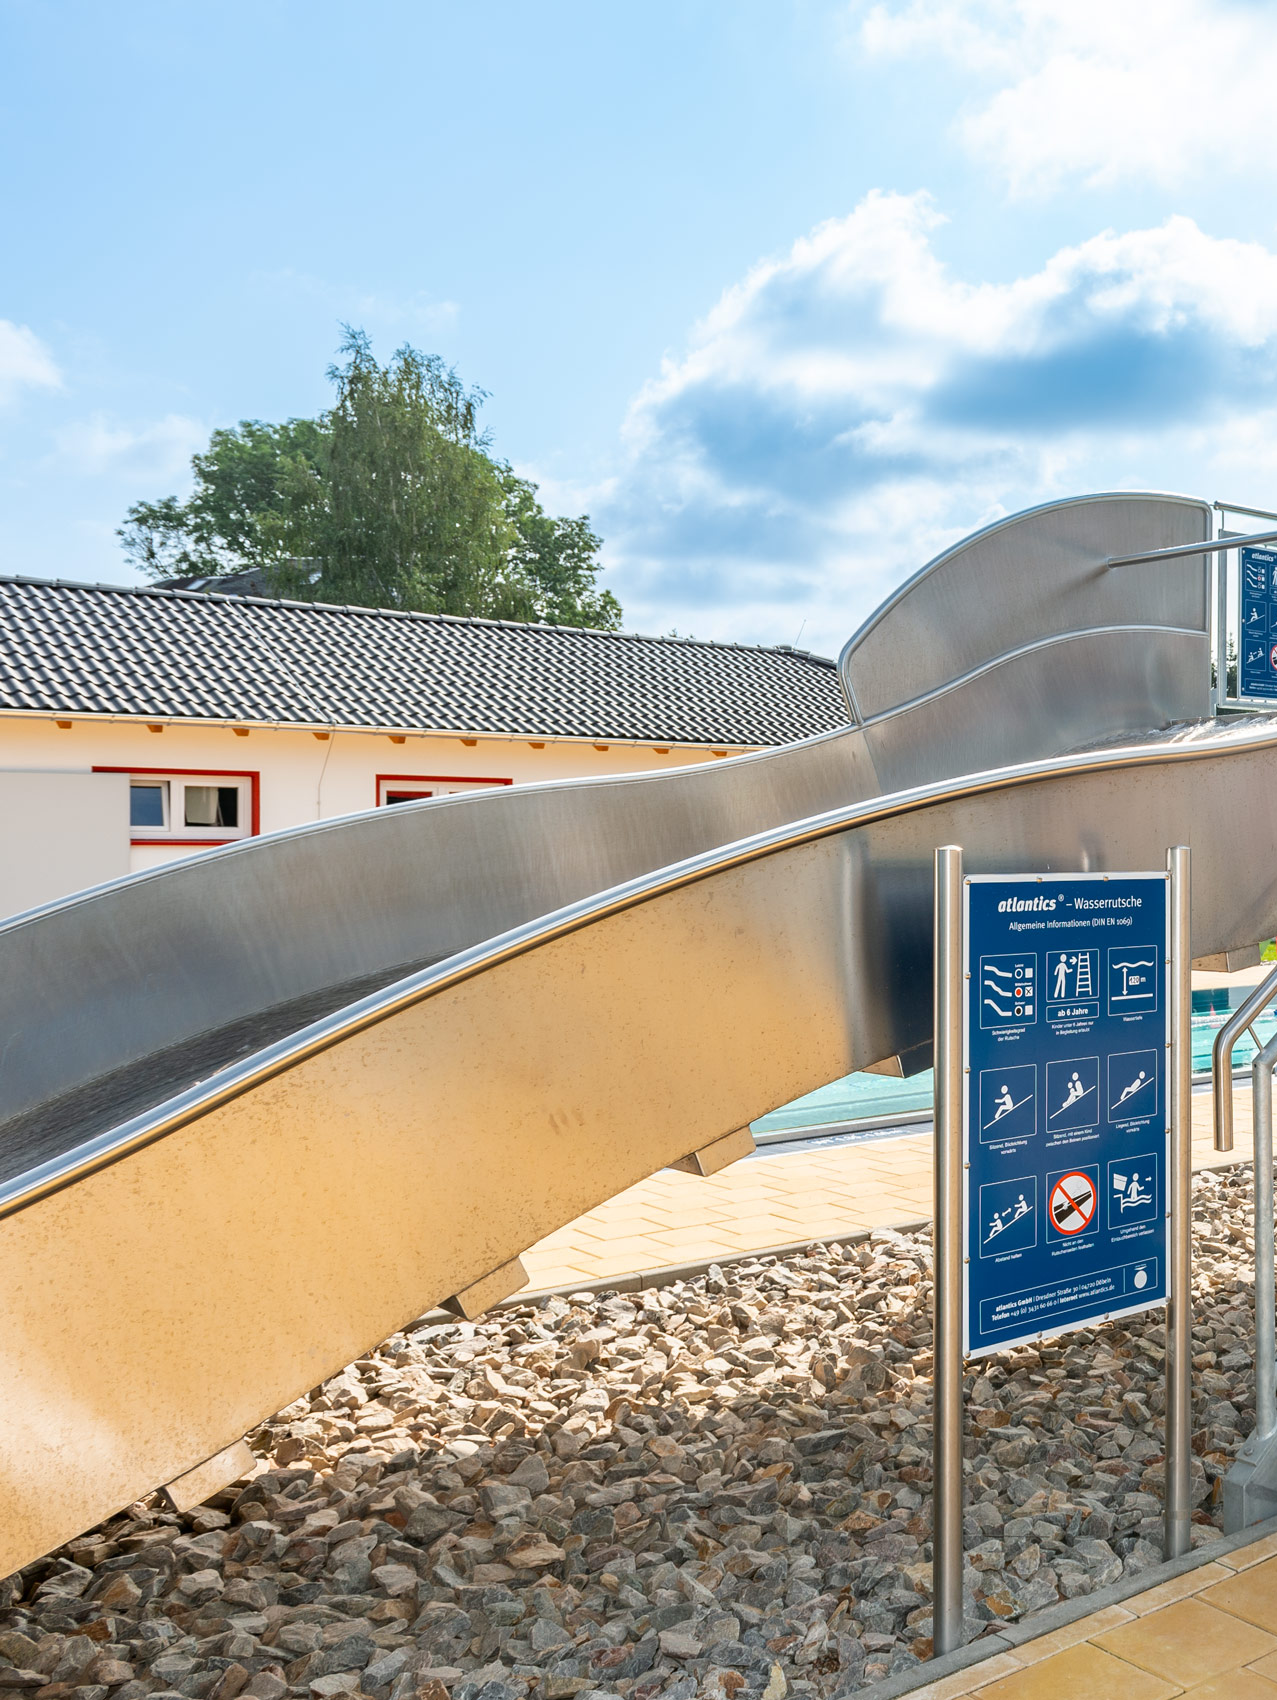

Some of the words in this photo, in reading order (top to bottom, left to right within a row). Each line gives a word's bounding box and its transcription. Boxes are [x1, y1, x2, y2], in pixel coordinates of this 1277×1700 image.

[1074, 896, 1142, 909] Wasserrutsche
[1009, 921, 1045, 932] Allgemeine
[1047, 919, 1091, 929] Informationen
[1092, 917, 1106, 927] (DIN
[1107, 918, 1116, 926] EN
[1117, 916, 1133, 927] 1069)
[1057, 1009, 1066, 1017] ab
[1072, 1007, 1089, 1016] Jahre
[991, 1312, 1010, 1322] Telefon
[1059, 1293, 1078, 1304] Internet
[995, 1302, 1018, 1313] atlantics
[1017, 1296, 1033, 1307] GmbH
